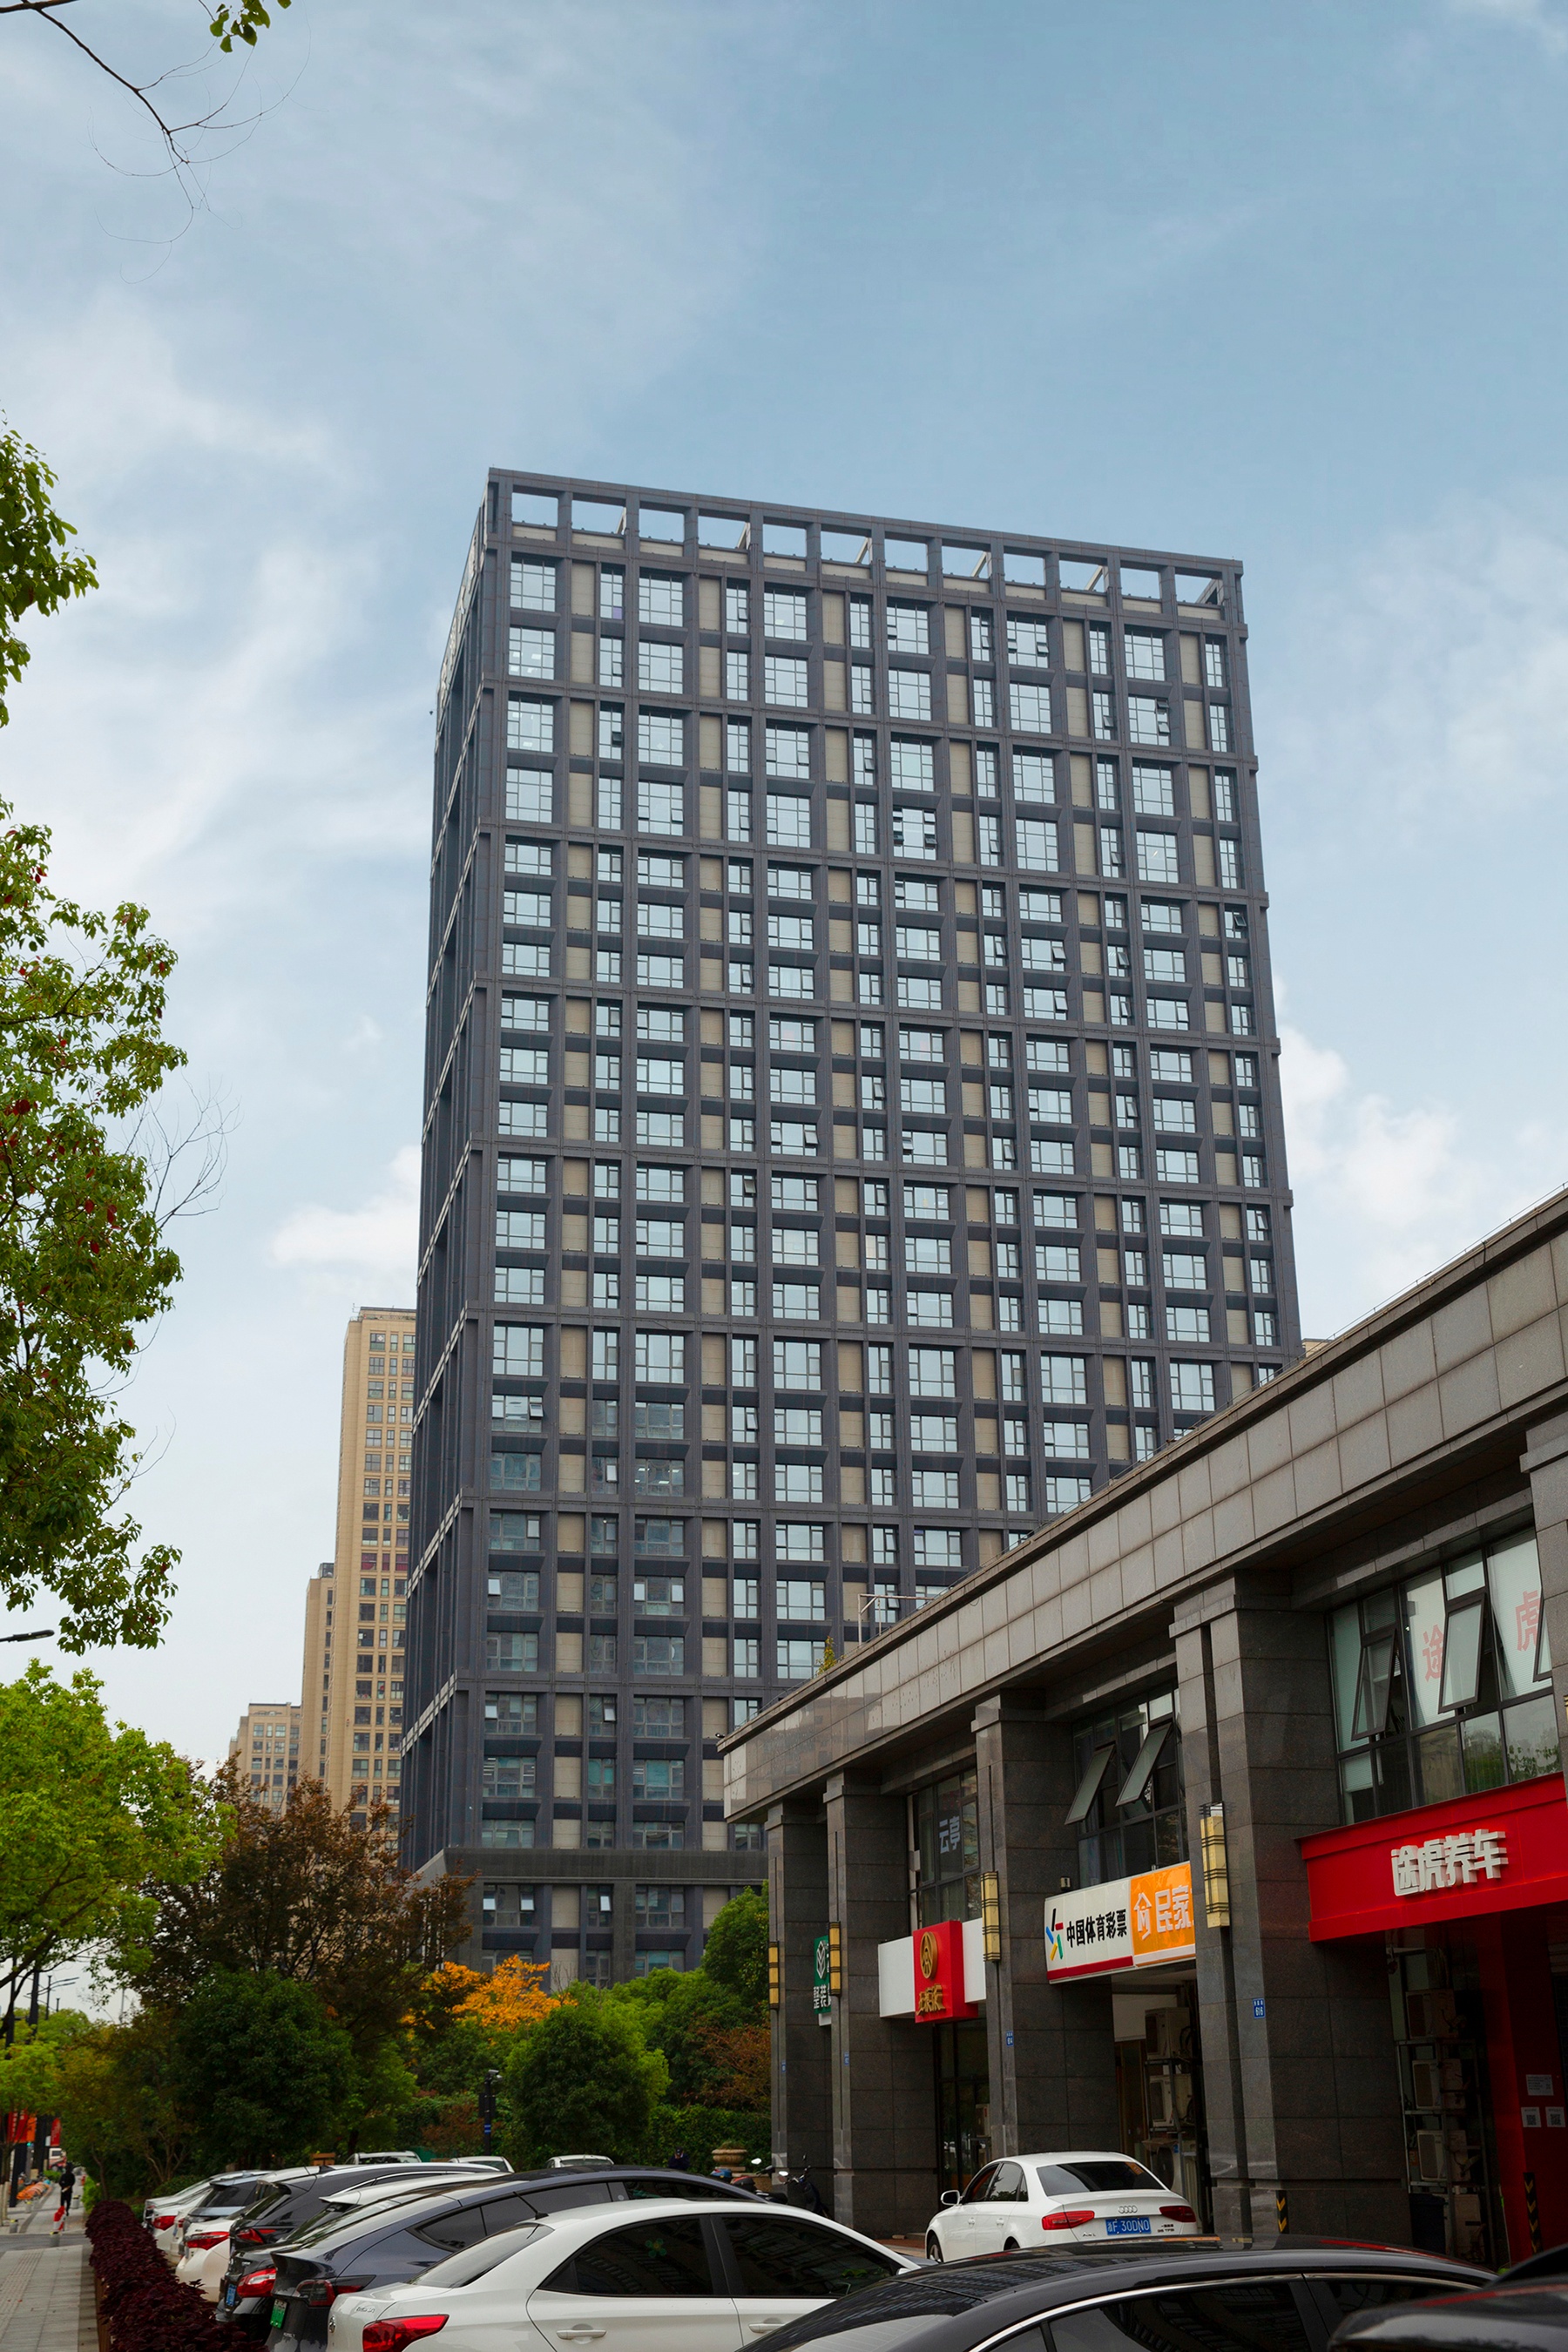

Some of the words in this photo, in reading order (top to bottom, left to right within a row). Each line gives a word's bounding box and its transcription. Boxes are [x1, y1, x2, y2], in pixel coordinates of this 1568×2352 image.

[1391, 1829, 1509, 1896] 途虎养车
[1066, 1909, 1127, 1948] 中国体育彩票
[1155, 1885, 1194, 1933] 民家
[813, 1983, 831, 2009] 整装
